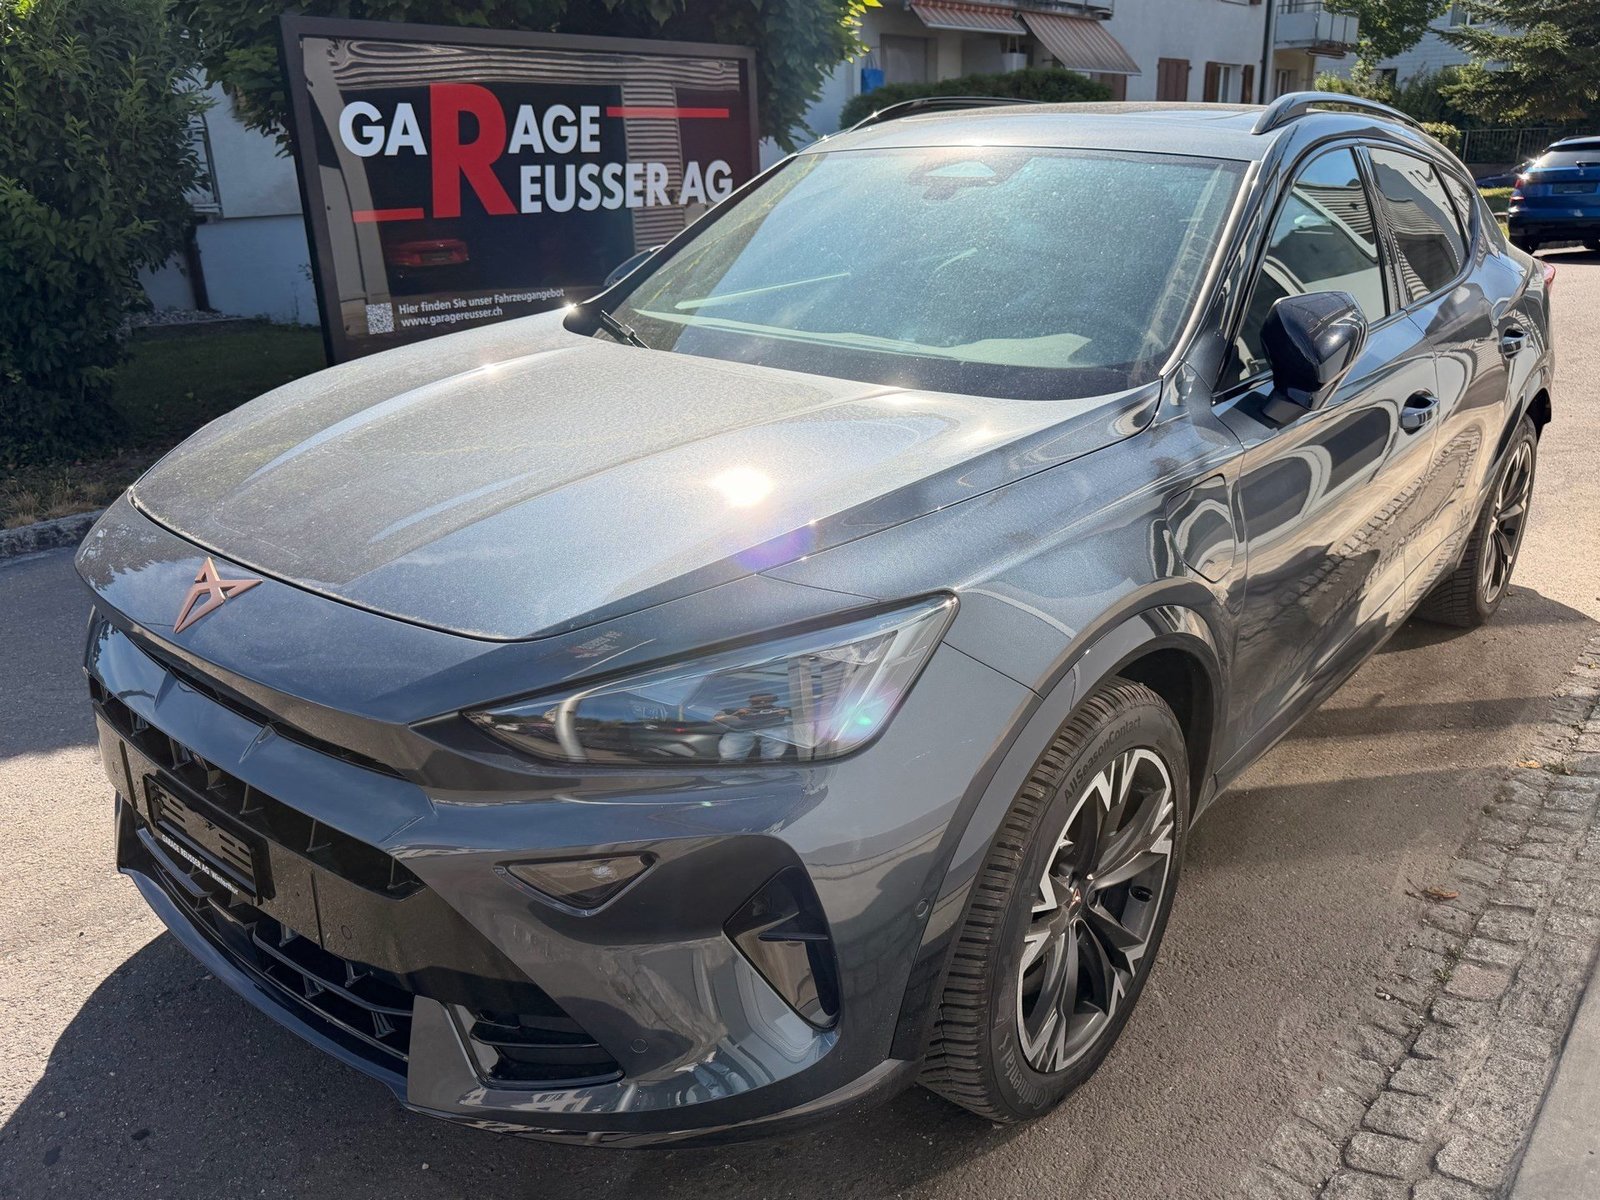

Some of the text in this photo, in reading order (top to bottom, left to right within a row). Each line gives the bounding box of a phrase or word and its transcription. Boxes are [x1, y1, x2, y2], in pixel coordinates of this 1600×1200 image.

[339, 83, 600, 218] GARAGE
[679, 160, 733, 207] AG
[398, 288, 565, 315] Hier finden Sie unser Fahrzeugangebot
[401, 308, 503, 327] www.garagereusser.ch
[1063, 715, 1141, 804] AllSeasonContact
